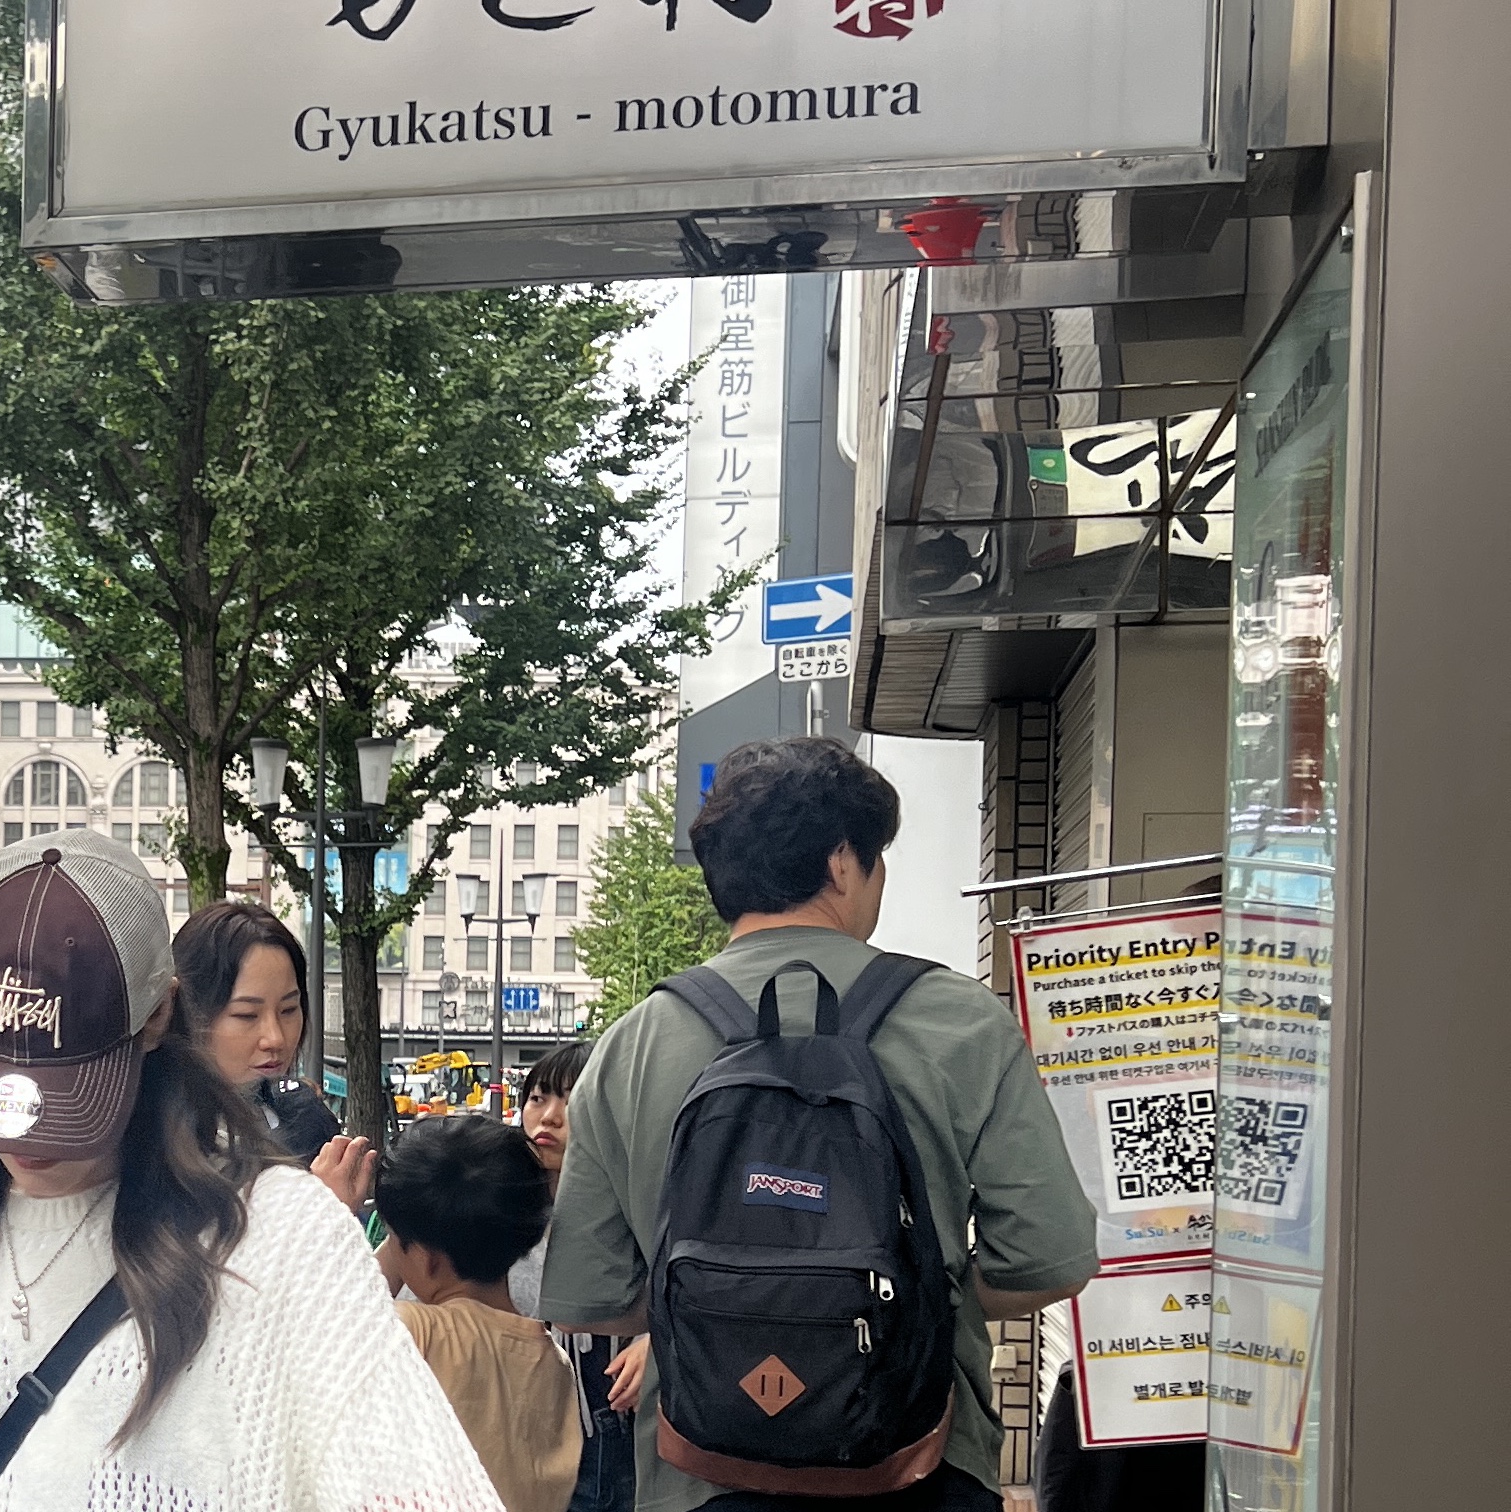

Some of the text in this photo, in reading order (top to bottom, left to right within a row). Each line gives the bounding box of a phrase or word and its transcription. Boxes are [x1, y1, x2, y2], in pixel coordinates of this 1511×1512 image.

[293, 99, 553, 161] Gyukatsu
[614, 80, 921, 133] motomura
[782, 644, 848, 662] 自転車を除く
[782, 658, 849, 678] ここから
[1027, 944, 1120, 972] Priority
[1128, 935, 1200, 960] Entry
[1033, 974, 1096, 993] Purchase
[1098, 974, 1107, 985] a
[1109, 969, 1148, 984] ticket
[1151, 967, 1166, 978] to
[1169, 963, 1198, 980] skip
[1036, 1049, 1093, 1067] 대기시간
[1099, 1044, 1128, 1060] 없이
[1133, 1041, 1162, 1056] 우선
[1167, 1037, 1197, 1053] 안내
[747, 1173, 824, 1198] JANSPORT
[1088, 1339, 1103, 1357] 이
[1109, 1335, 1175, 1354] 서비스는
[1133, 1382, 1183, 1401] 별개로
